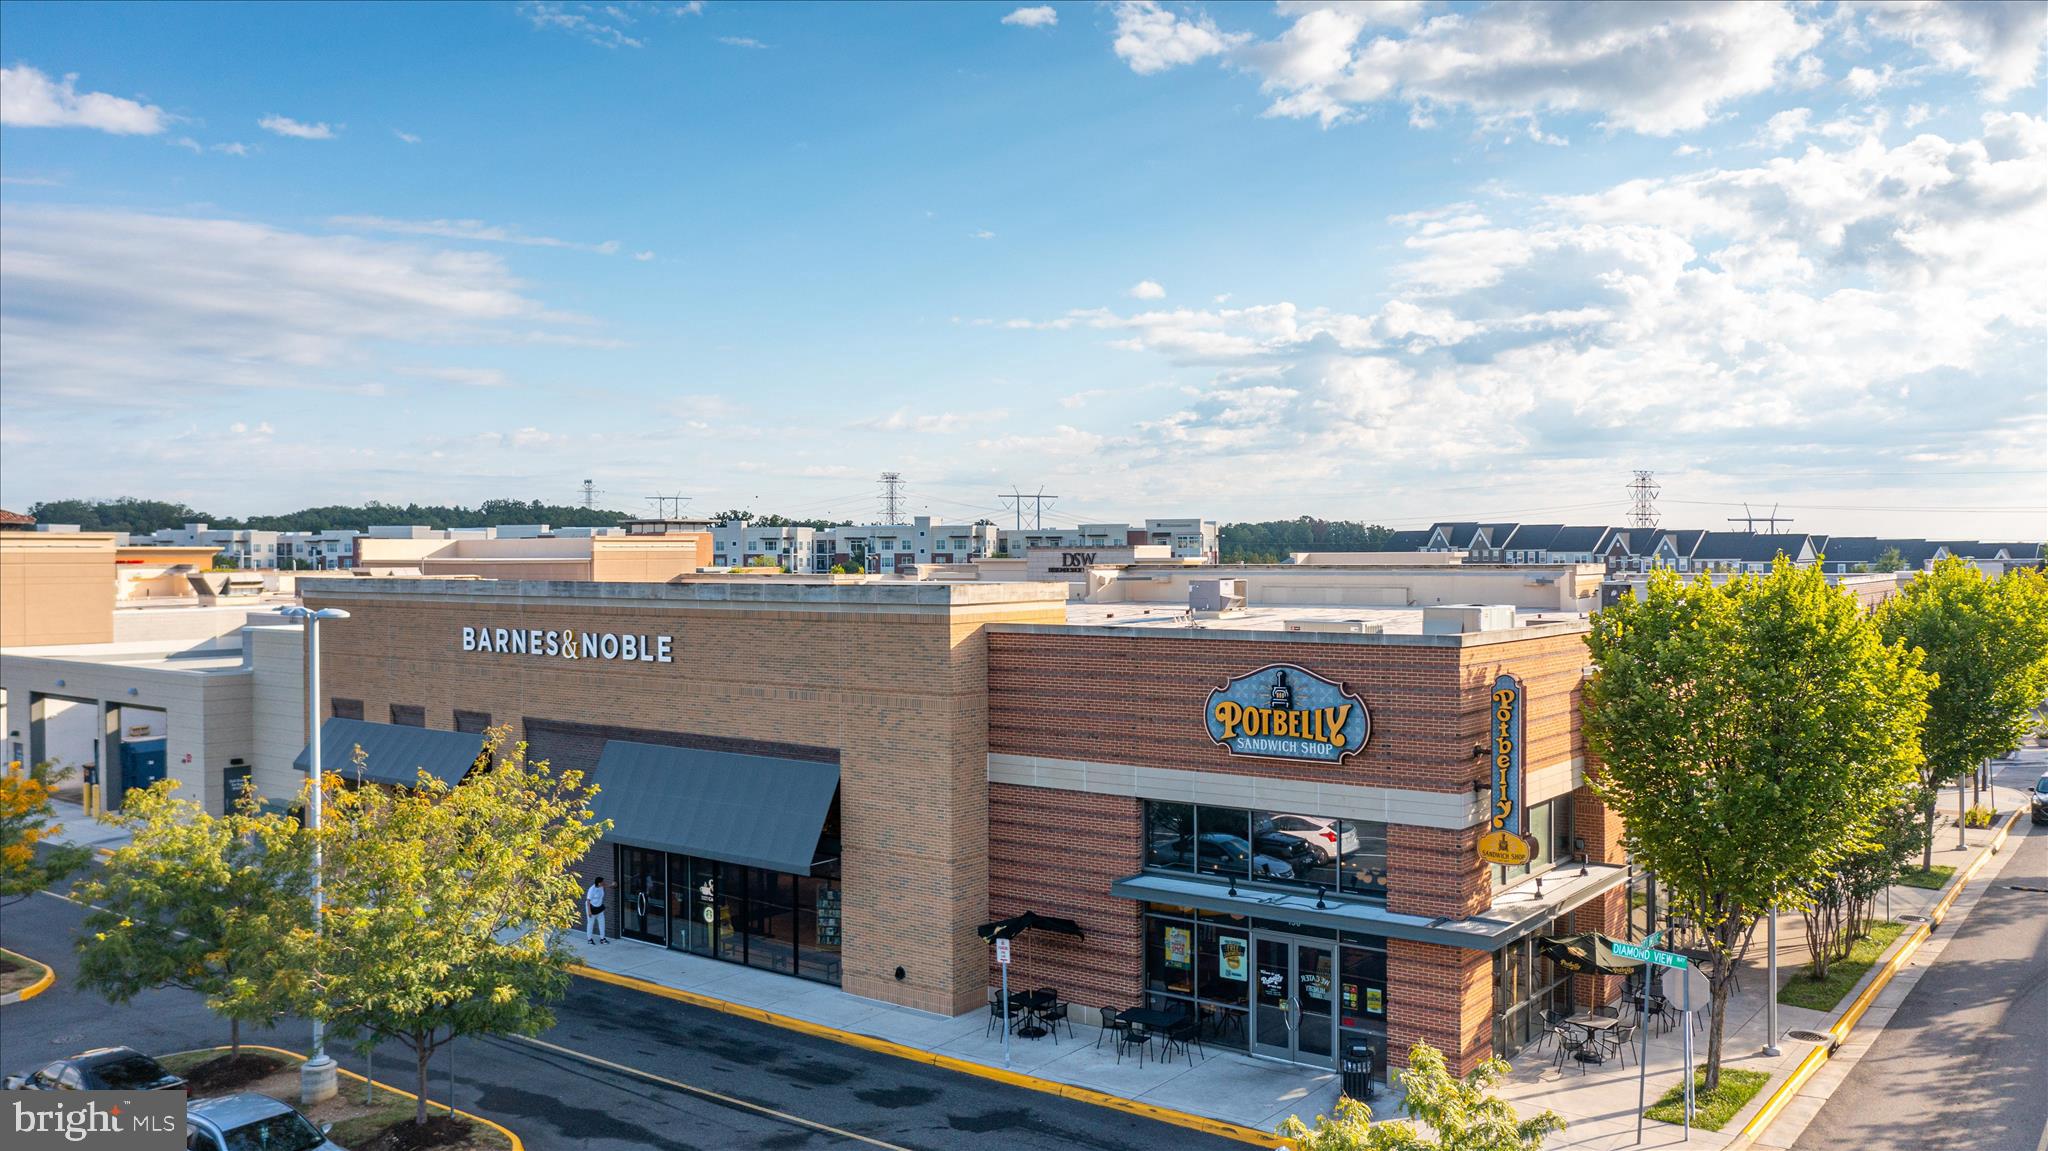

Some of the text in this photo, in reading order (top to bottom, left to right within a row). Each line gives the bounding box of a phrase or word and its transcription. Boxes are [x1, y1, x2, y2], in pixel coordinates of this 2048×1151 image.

[1062, 553, 1096, 567] DSW
[463, 627, 673, 662] BARNES&NOBLE
[1215, 701, 1353, 747] POTBELLY
[1237, 738, 1333, 755] SANDWICH SHOP
[1493, 689, 1514, 828] Potbelly
[1482, 849, 1509, 859] SANDWICH
[1613, 943, 1650, 960] DIAMOND
[1654, 951, 1673, 965] VIEW
